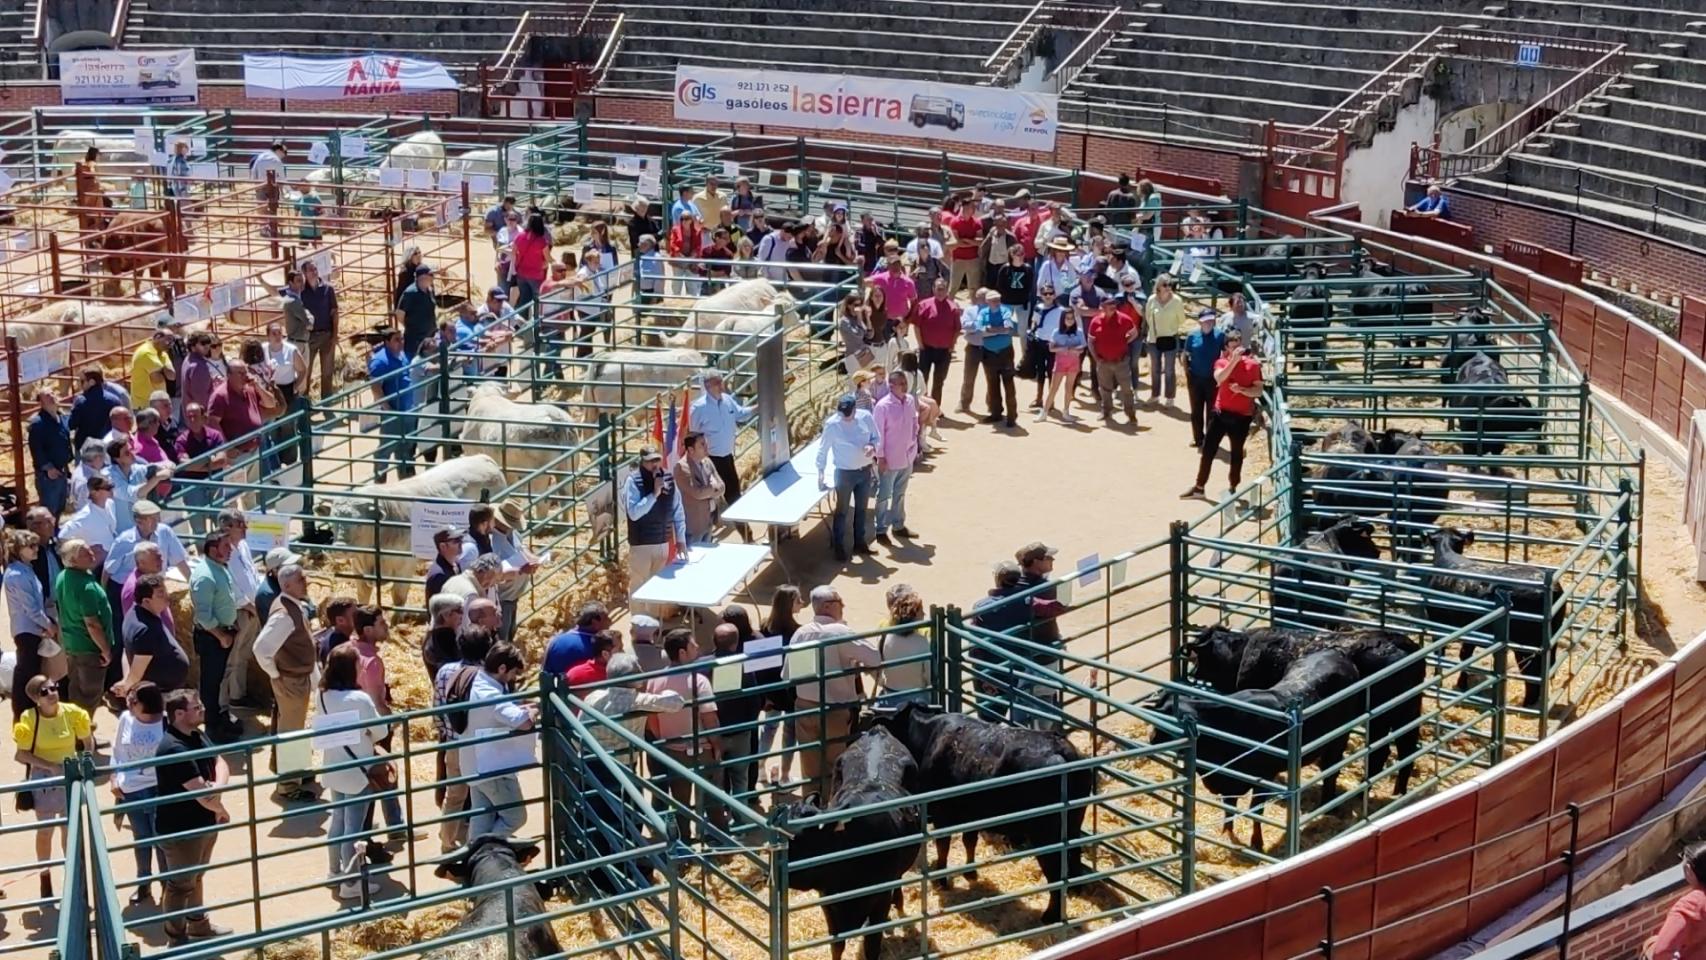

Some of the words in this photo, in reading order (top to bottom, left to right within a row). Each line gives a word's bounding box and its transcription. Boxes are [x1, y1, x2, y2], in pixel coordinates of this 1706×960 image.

[343, 82, 401, 96] NANTA
[691, 83, 717, 102] gls
[737, 82, 753, 91] 921
[773, 83, 789, 92] 252
[792, 85, 902, 120] lasierra
[1010, 271, 1025, 289] K
